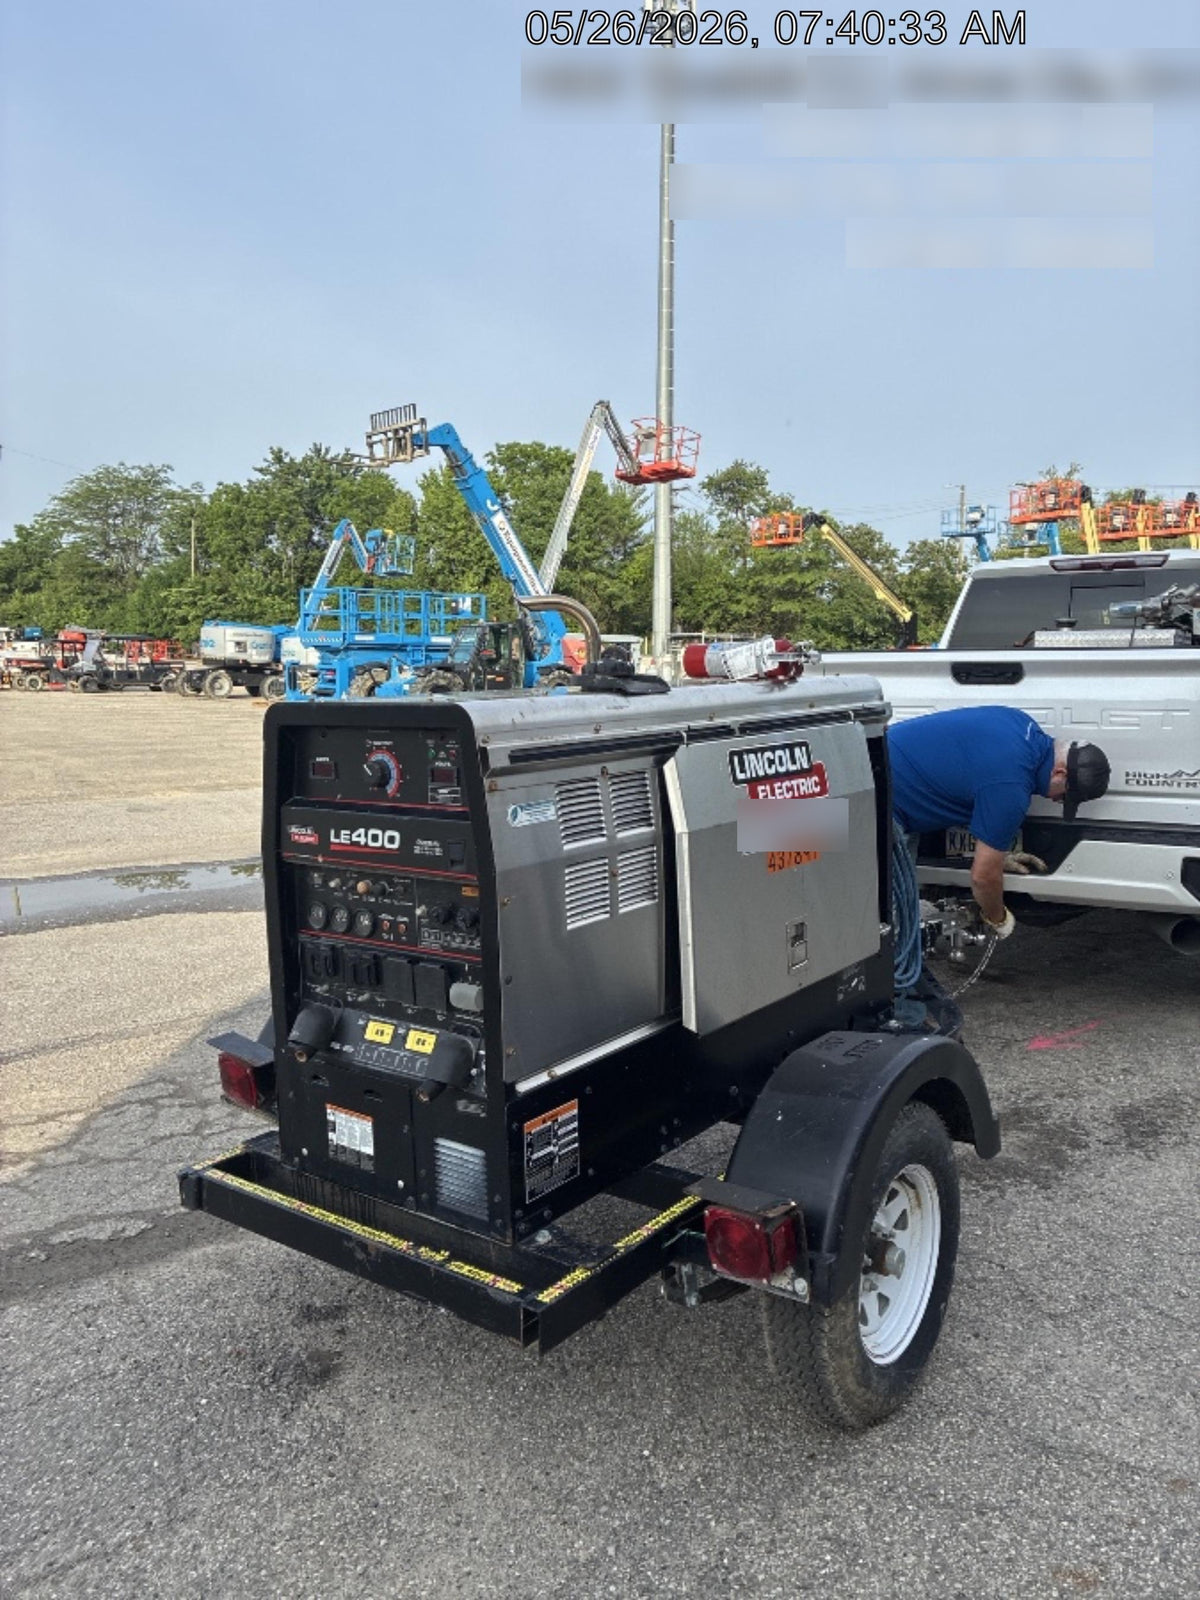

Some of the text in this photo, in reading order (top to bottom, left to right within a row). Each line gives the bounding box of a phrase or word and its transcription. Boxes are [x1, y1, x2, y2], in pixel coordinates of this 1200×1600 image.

[733, 746, 810, 779] LINCOLN
[757, 776, 821, 799] ELECTRIC
[330, 828, 400, 849] LE400
